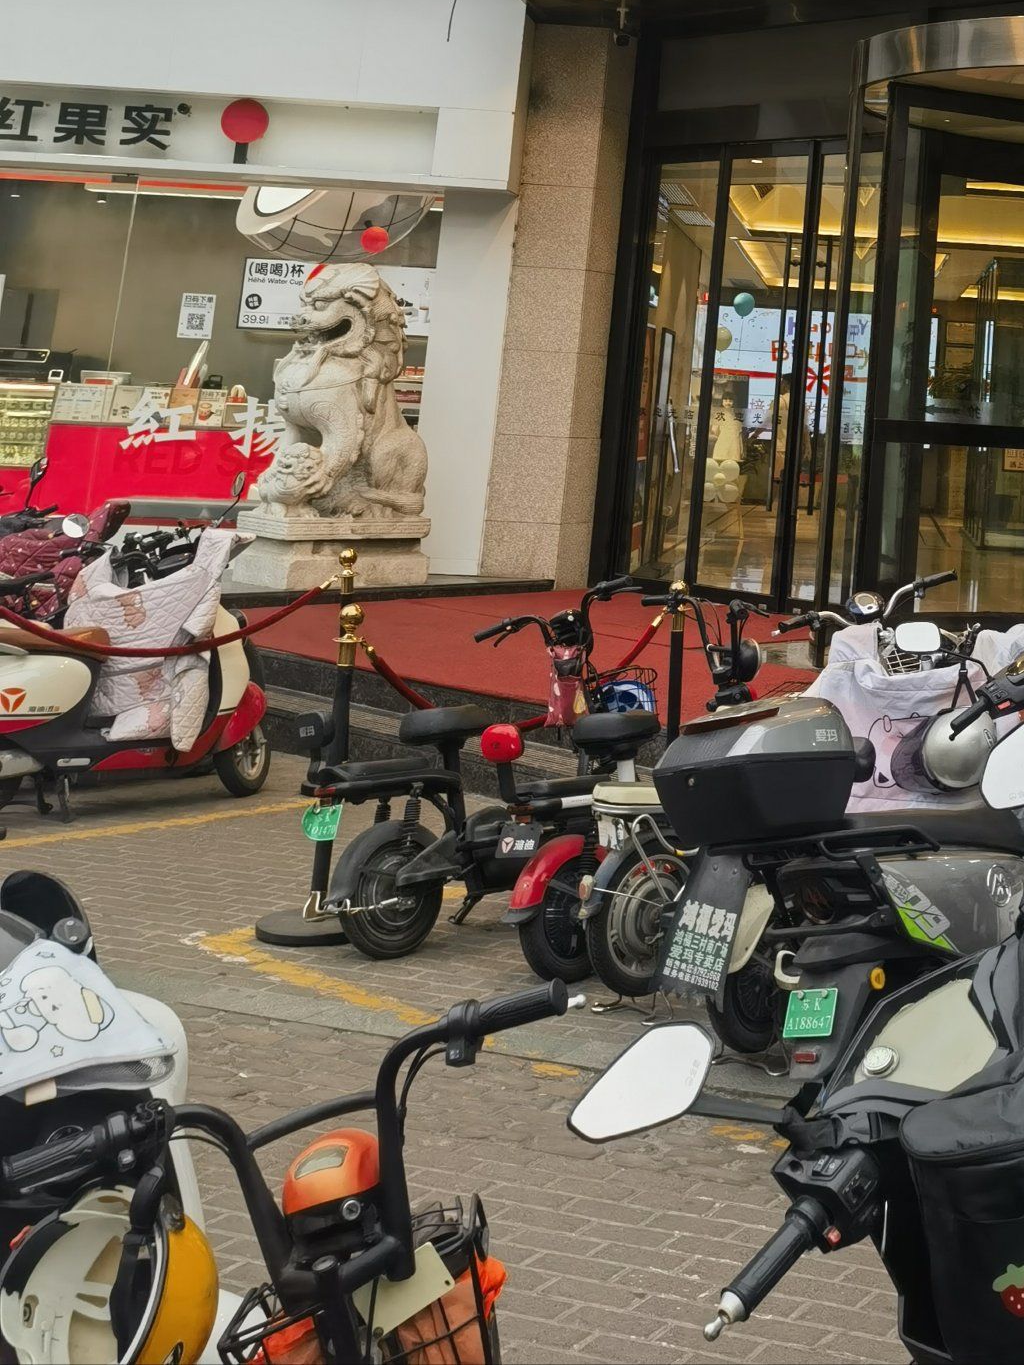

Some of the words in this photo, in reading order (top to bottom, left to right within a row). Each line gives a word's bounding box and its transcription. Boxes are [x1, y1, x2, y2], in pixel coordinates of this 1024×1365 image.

[0, 96, 173, 151] 红果实
[242, 314, 266, 325] 39.9
[815, 728, 838, 742] 爱玛
[785, 1015, 832, 1031] A188647
